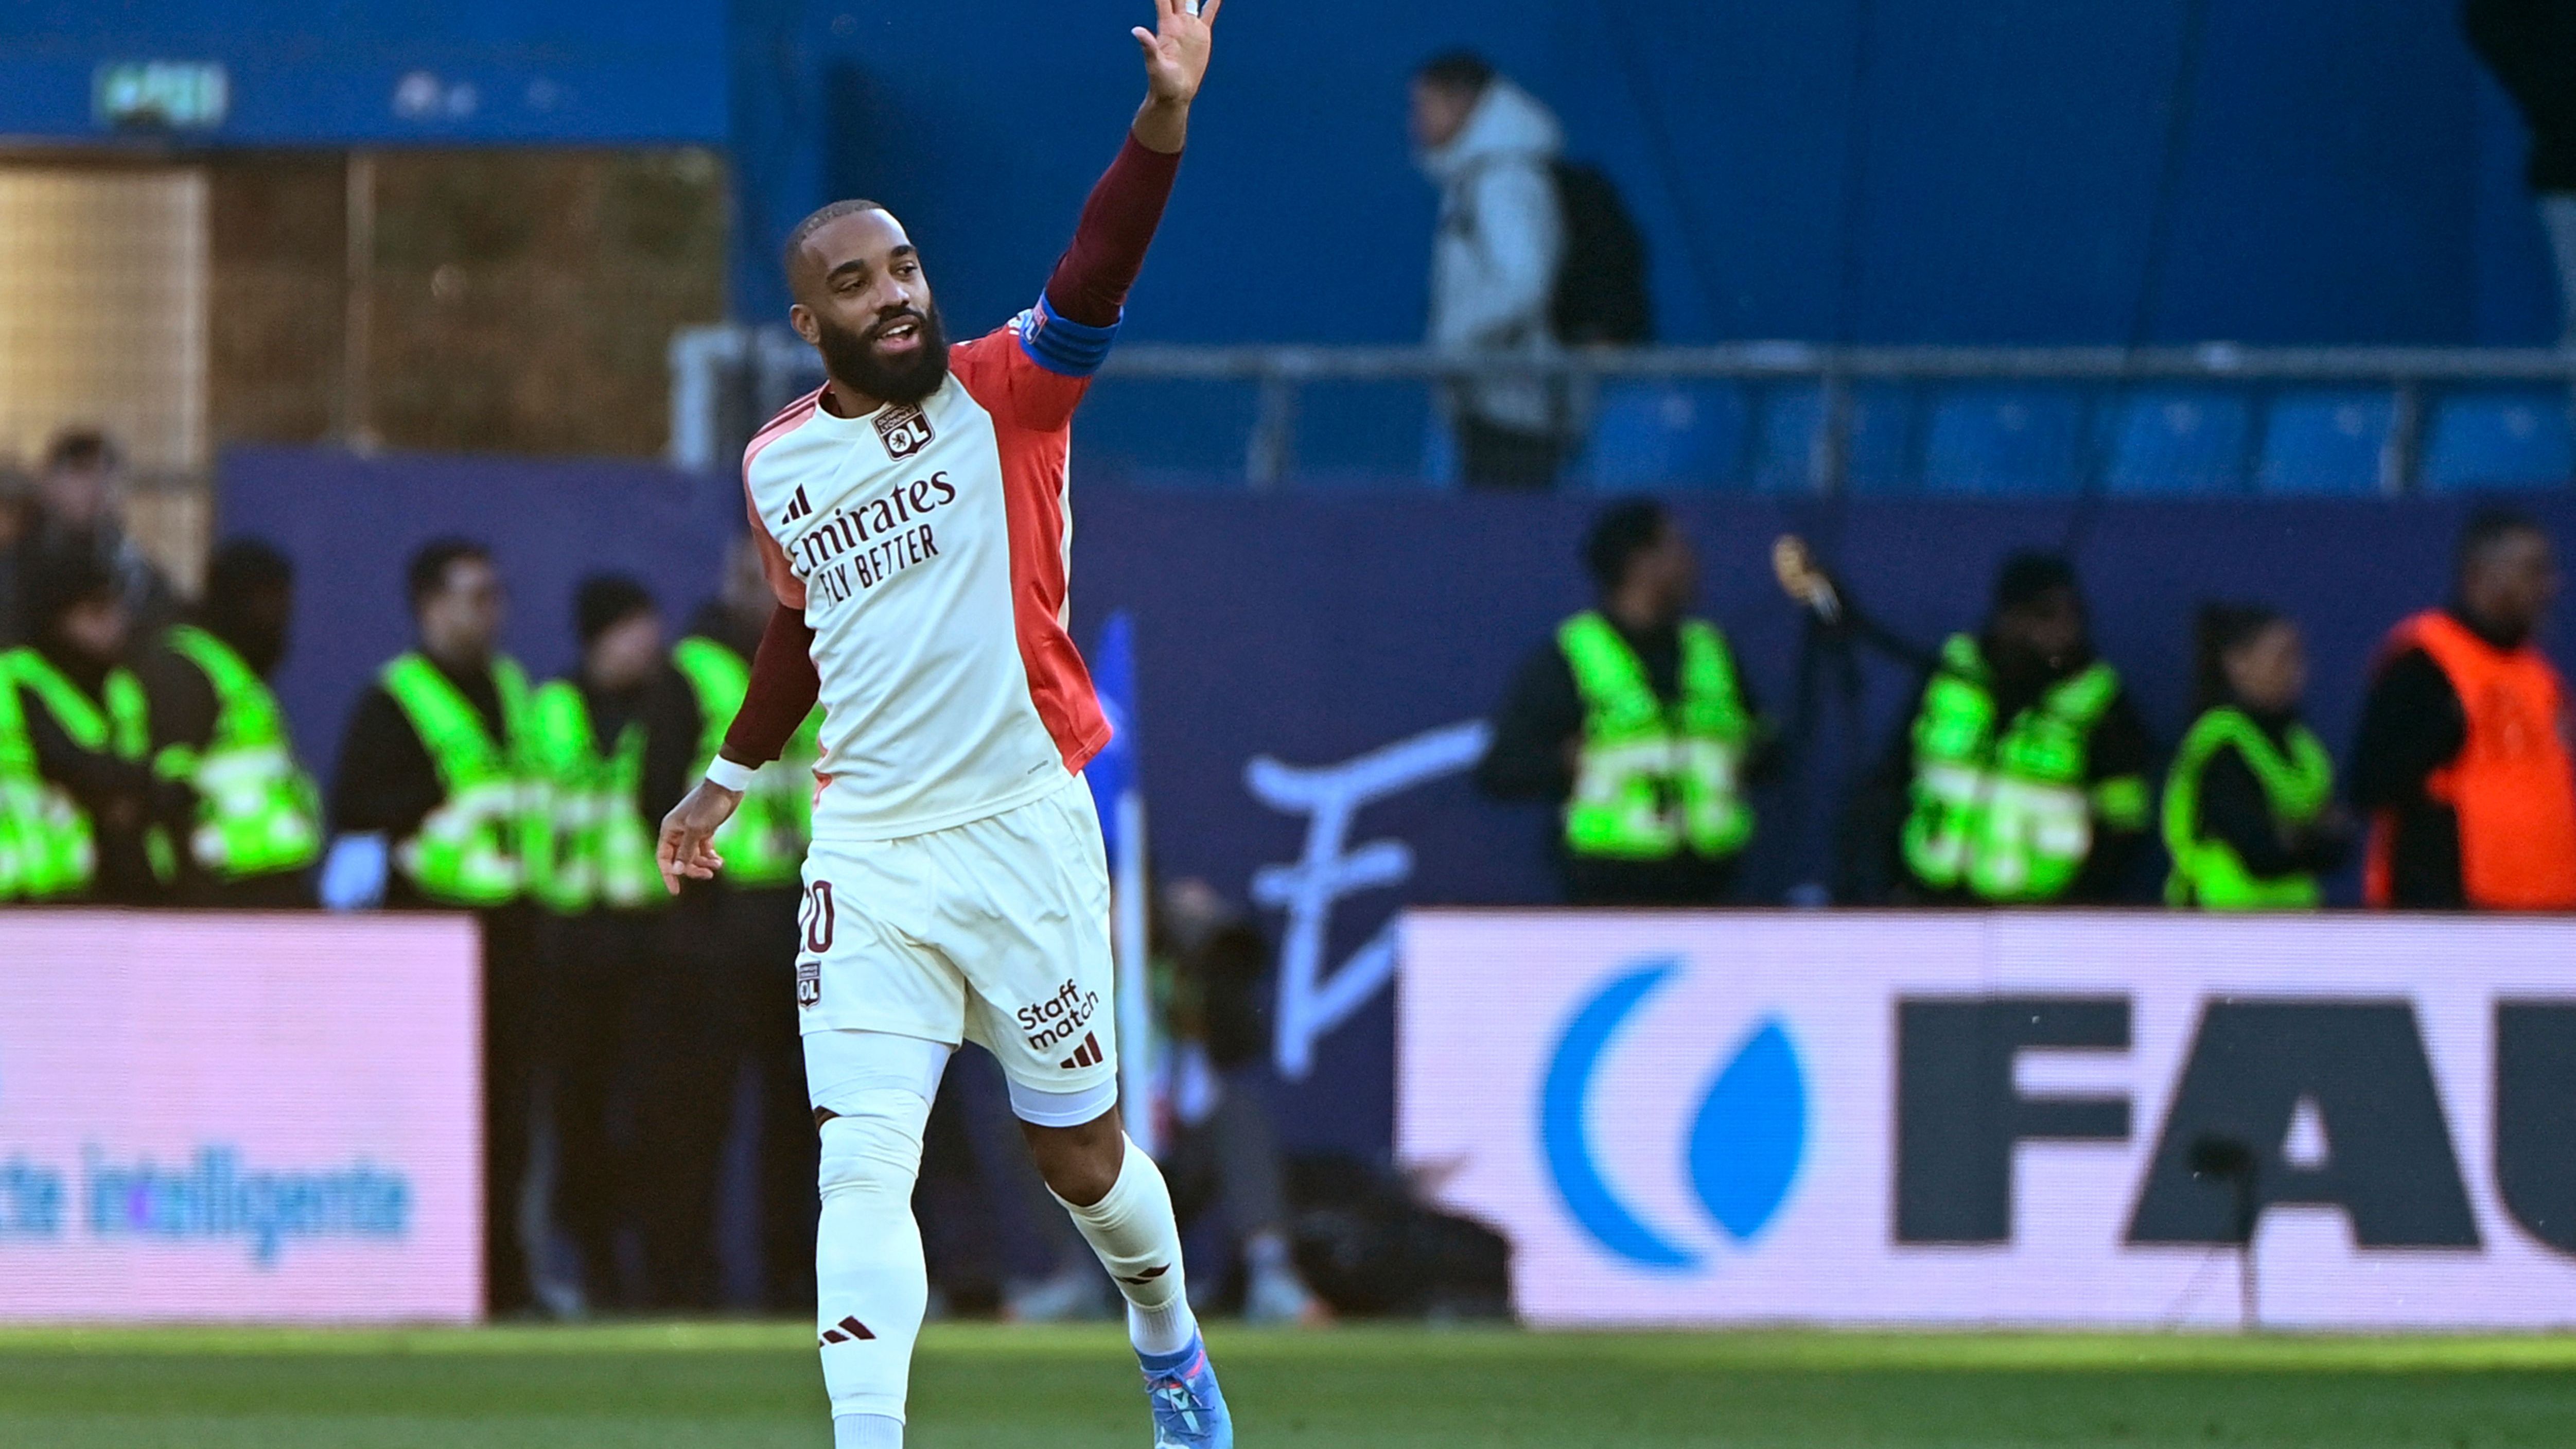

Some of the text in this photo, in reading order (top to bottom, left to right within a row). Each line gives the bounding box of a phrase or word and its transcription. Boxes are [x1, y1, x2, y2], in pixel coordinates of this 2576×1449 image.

[888, 420, 929, 452] OL
[819, 523, 939, 607] FLY BETTER
[799, 981, 818, 1001] OL
[1017, 978, 1080, 1030] Staff
[1028, 990, 1099, 1050] match
[84, 1143, 413, 1269] intelligente
